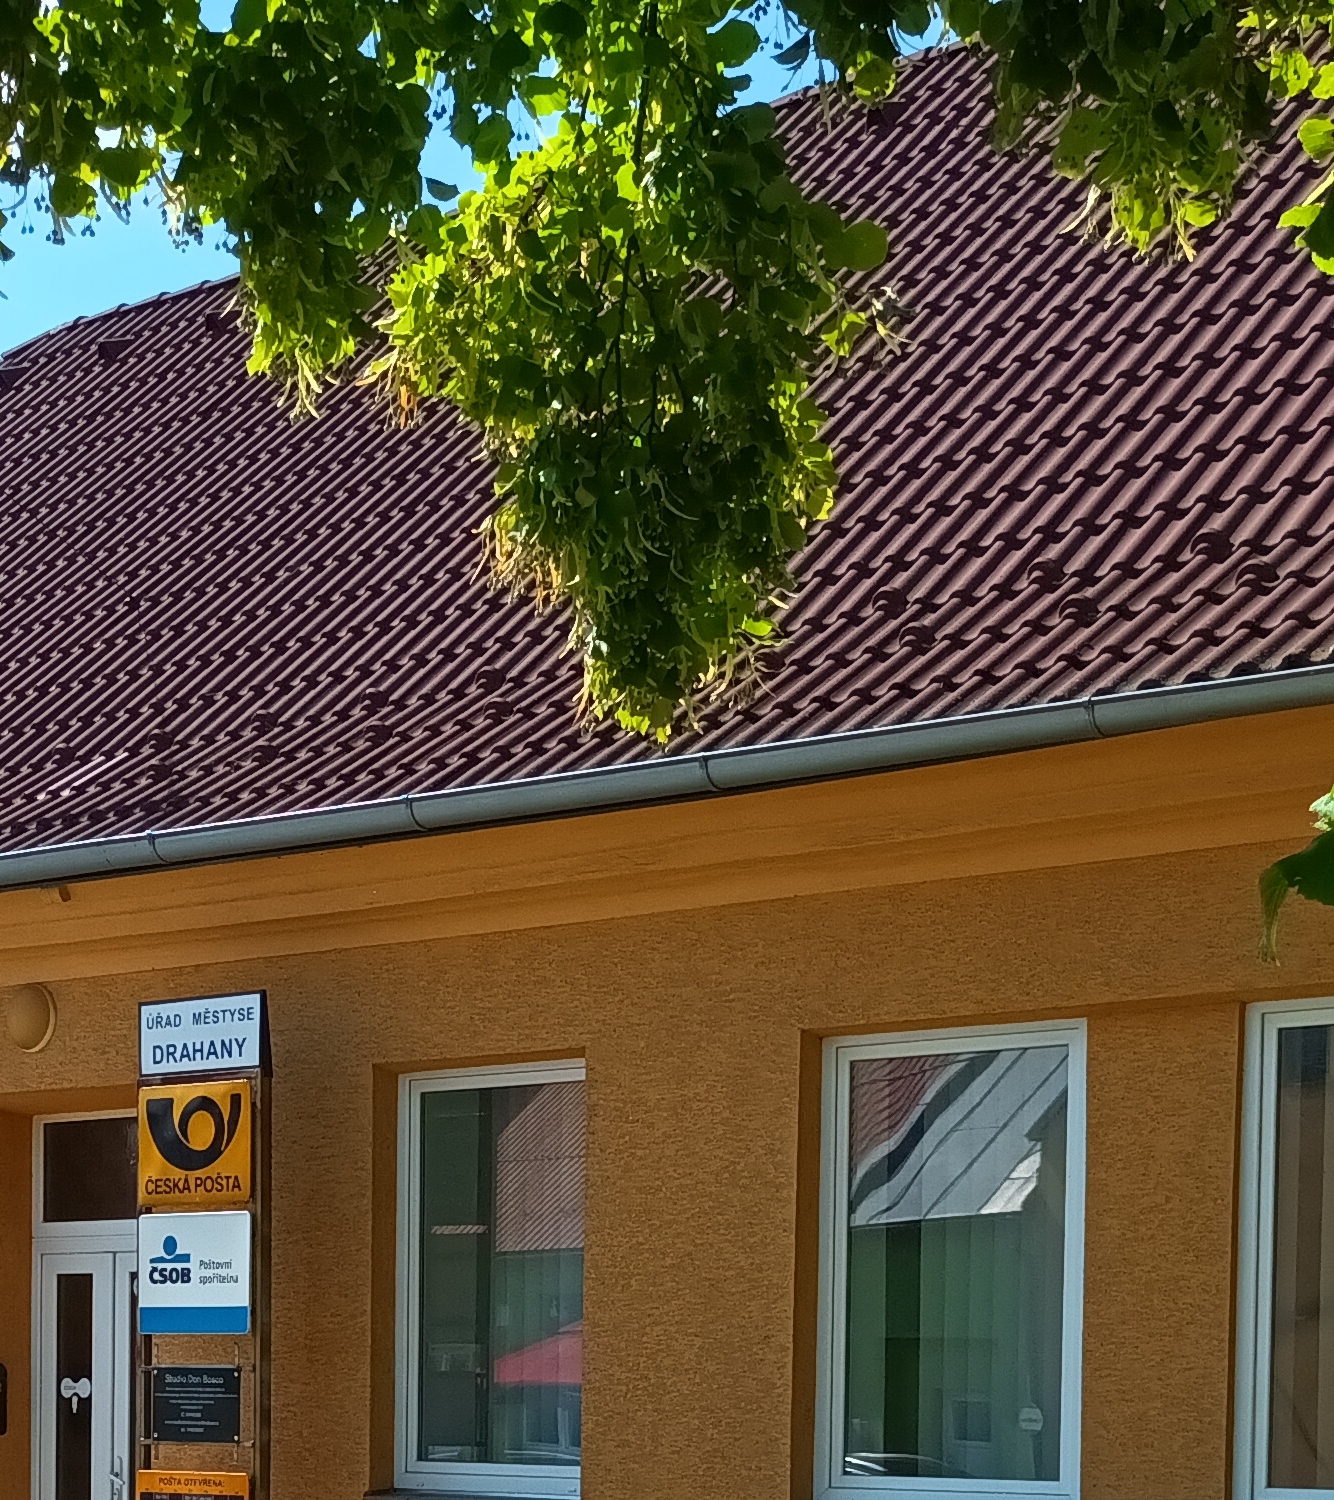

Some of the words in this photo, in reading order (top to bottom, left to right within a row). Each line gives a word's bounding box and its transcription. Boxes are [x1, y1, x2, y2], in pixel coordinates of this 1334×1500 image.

[146, 1012, 182, 1030] ÚŘAD
[192, 1006, 255, 1026] MĚSTYSE
[152, 1037, 247, 1065] DRAHANY
[145, 1174, 192, 1196] ČESKÁ
[194, 1172, 242, 1194] POŠTA
[198, 1258, 233, 1270] Poštovní
[148, 1265, 192, 1284] ČSOB
[198, 1273, 239, 1286] spořitelna
[158, 1475, 182, 1486] POŠTA
